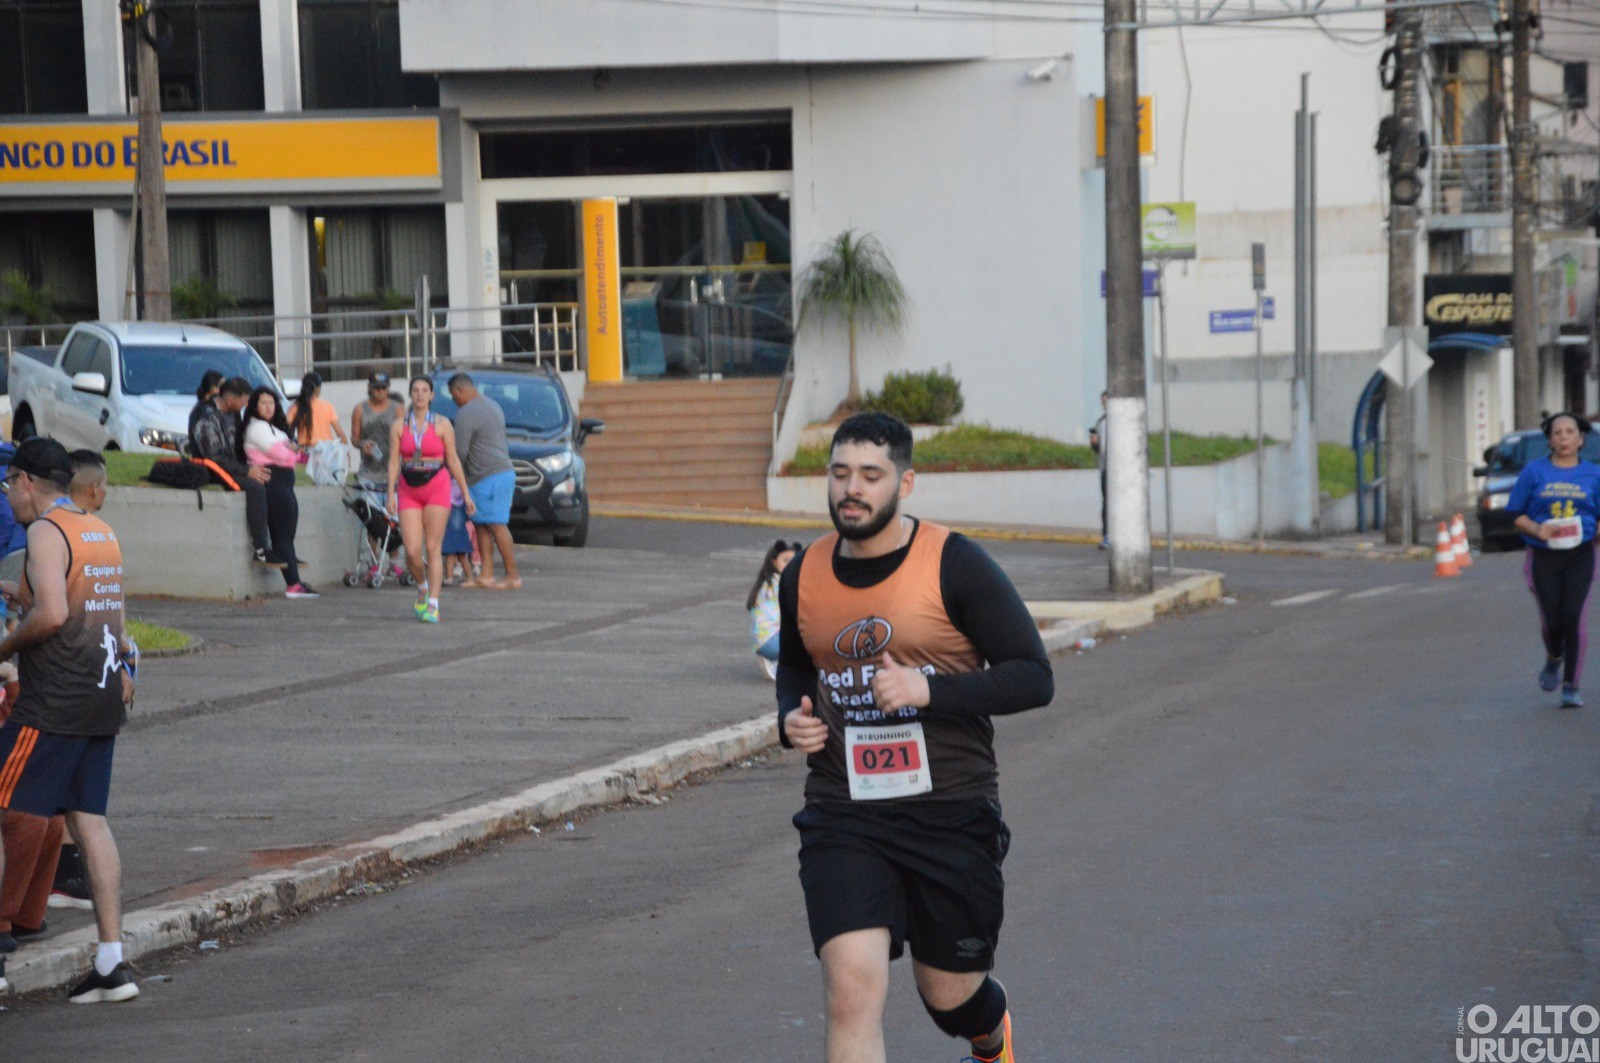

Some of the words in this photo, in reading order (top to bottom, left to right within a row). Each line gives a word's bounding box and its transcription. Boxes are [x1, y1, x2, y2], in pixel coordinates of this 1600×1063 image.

[72, 140, 116, 168] DO
[596, 214, 608, 335] Autoatendimento
[84, 564, 115, 578] Equipe
[85, 599, 105, 611] Med
[862, 746, 910, 770] 021
